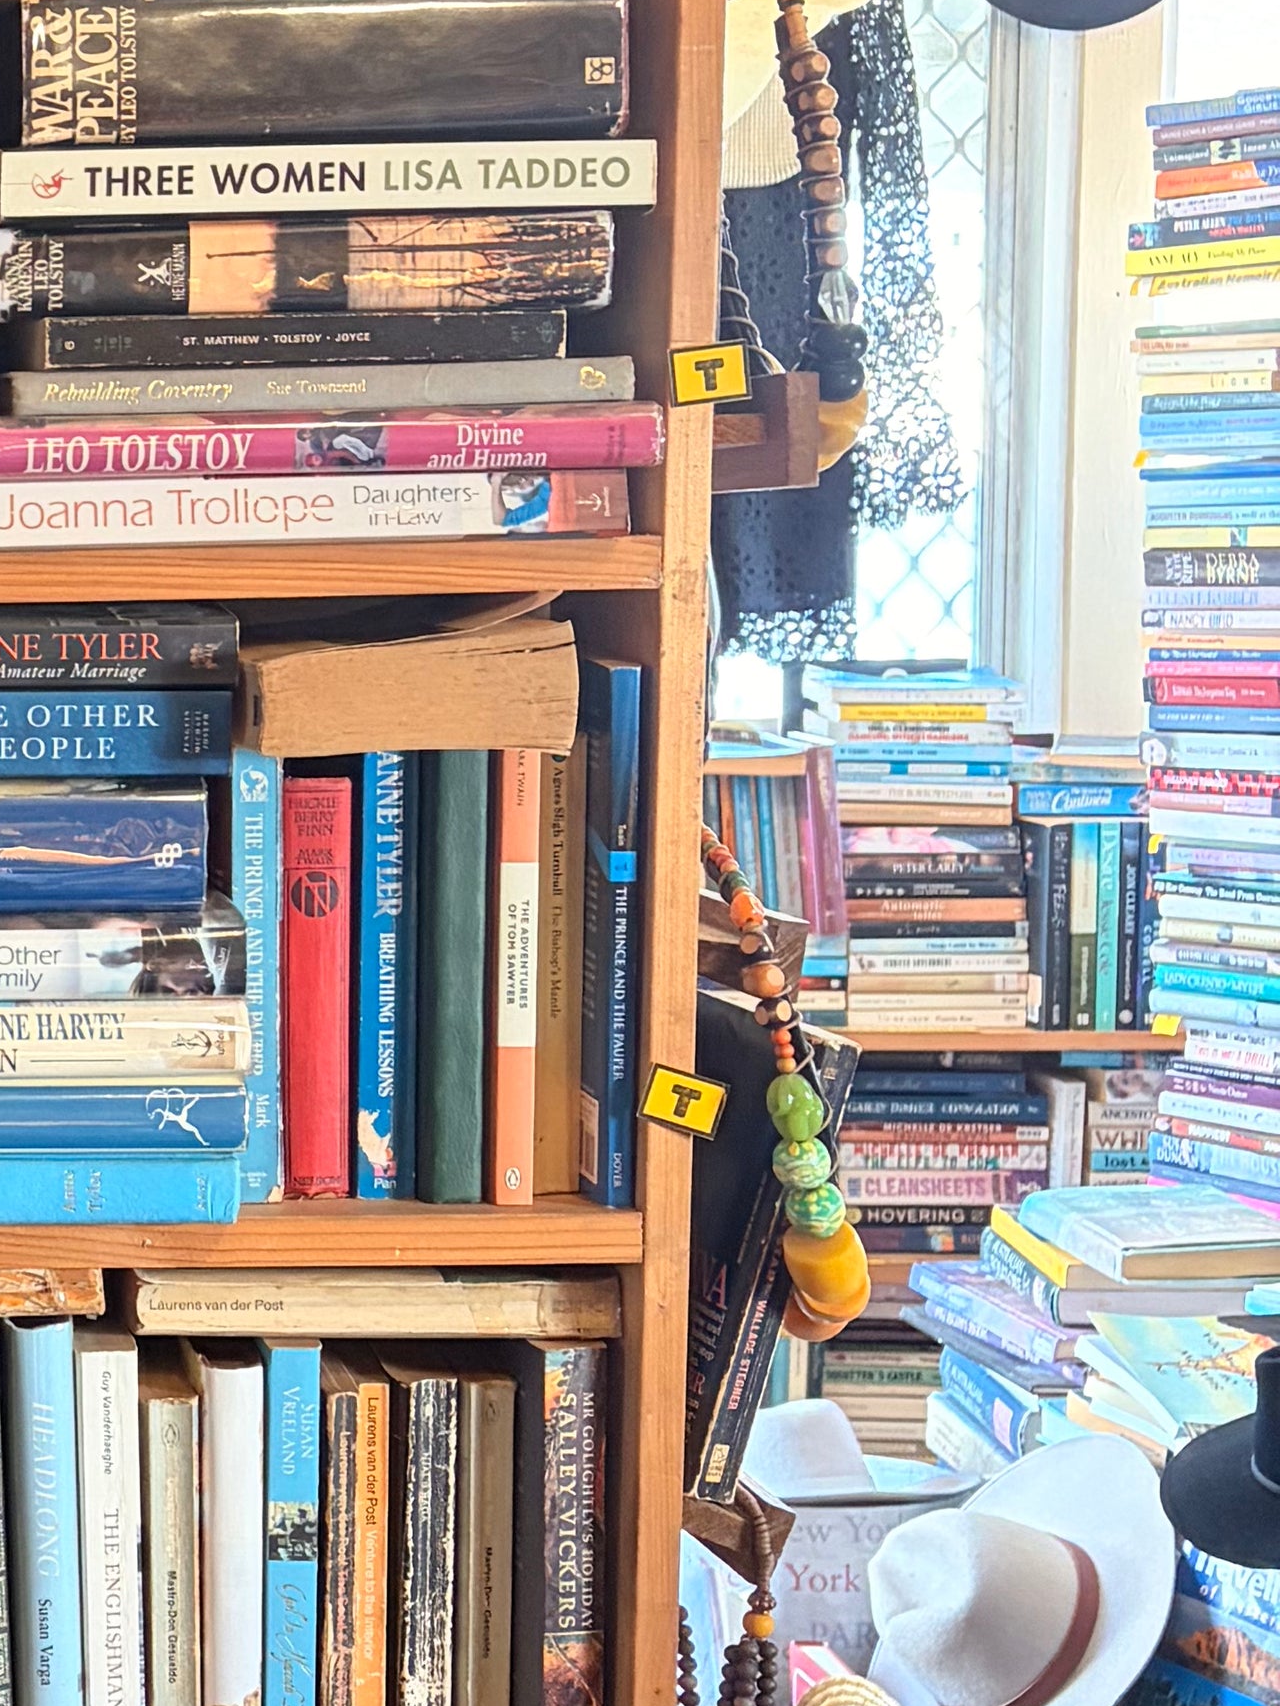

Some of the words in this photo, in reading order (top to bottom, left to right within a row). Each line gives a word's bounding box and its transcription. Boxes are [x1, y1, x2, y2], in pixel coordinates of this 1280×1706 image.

[85, 164, 194, 197] THREE
[211, 160, 366, 193] WOMEN
[383, 159, 462, 190] LISA
[478, 155, 631, 189] TADDEO
[694, 357, 726, 392] T
[167, 486, 335, 525] Trollope
[53, 633, 162, 661] TYLER
[27, 704, 159, 728] OTHER
[670, 1081, 702, 1117] T
